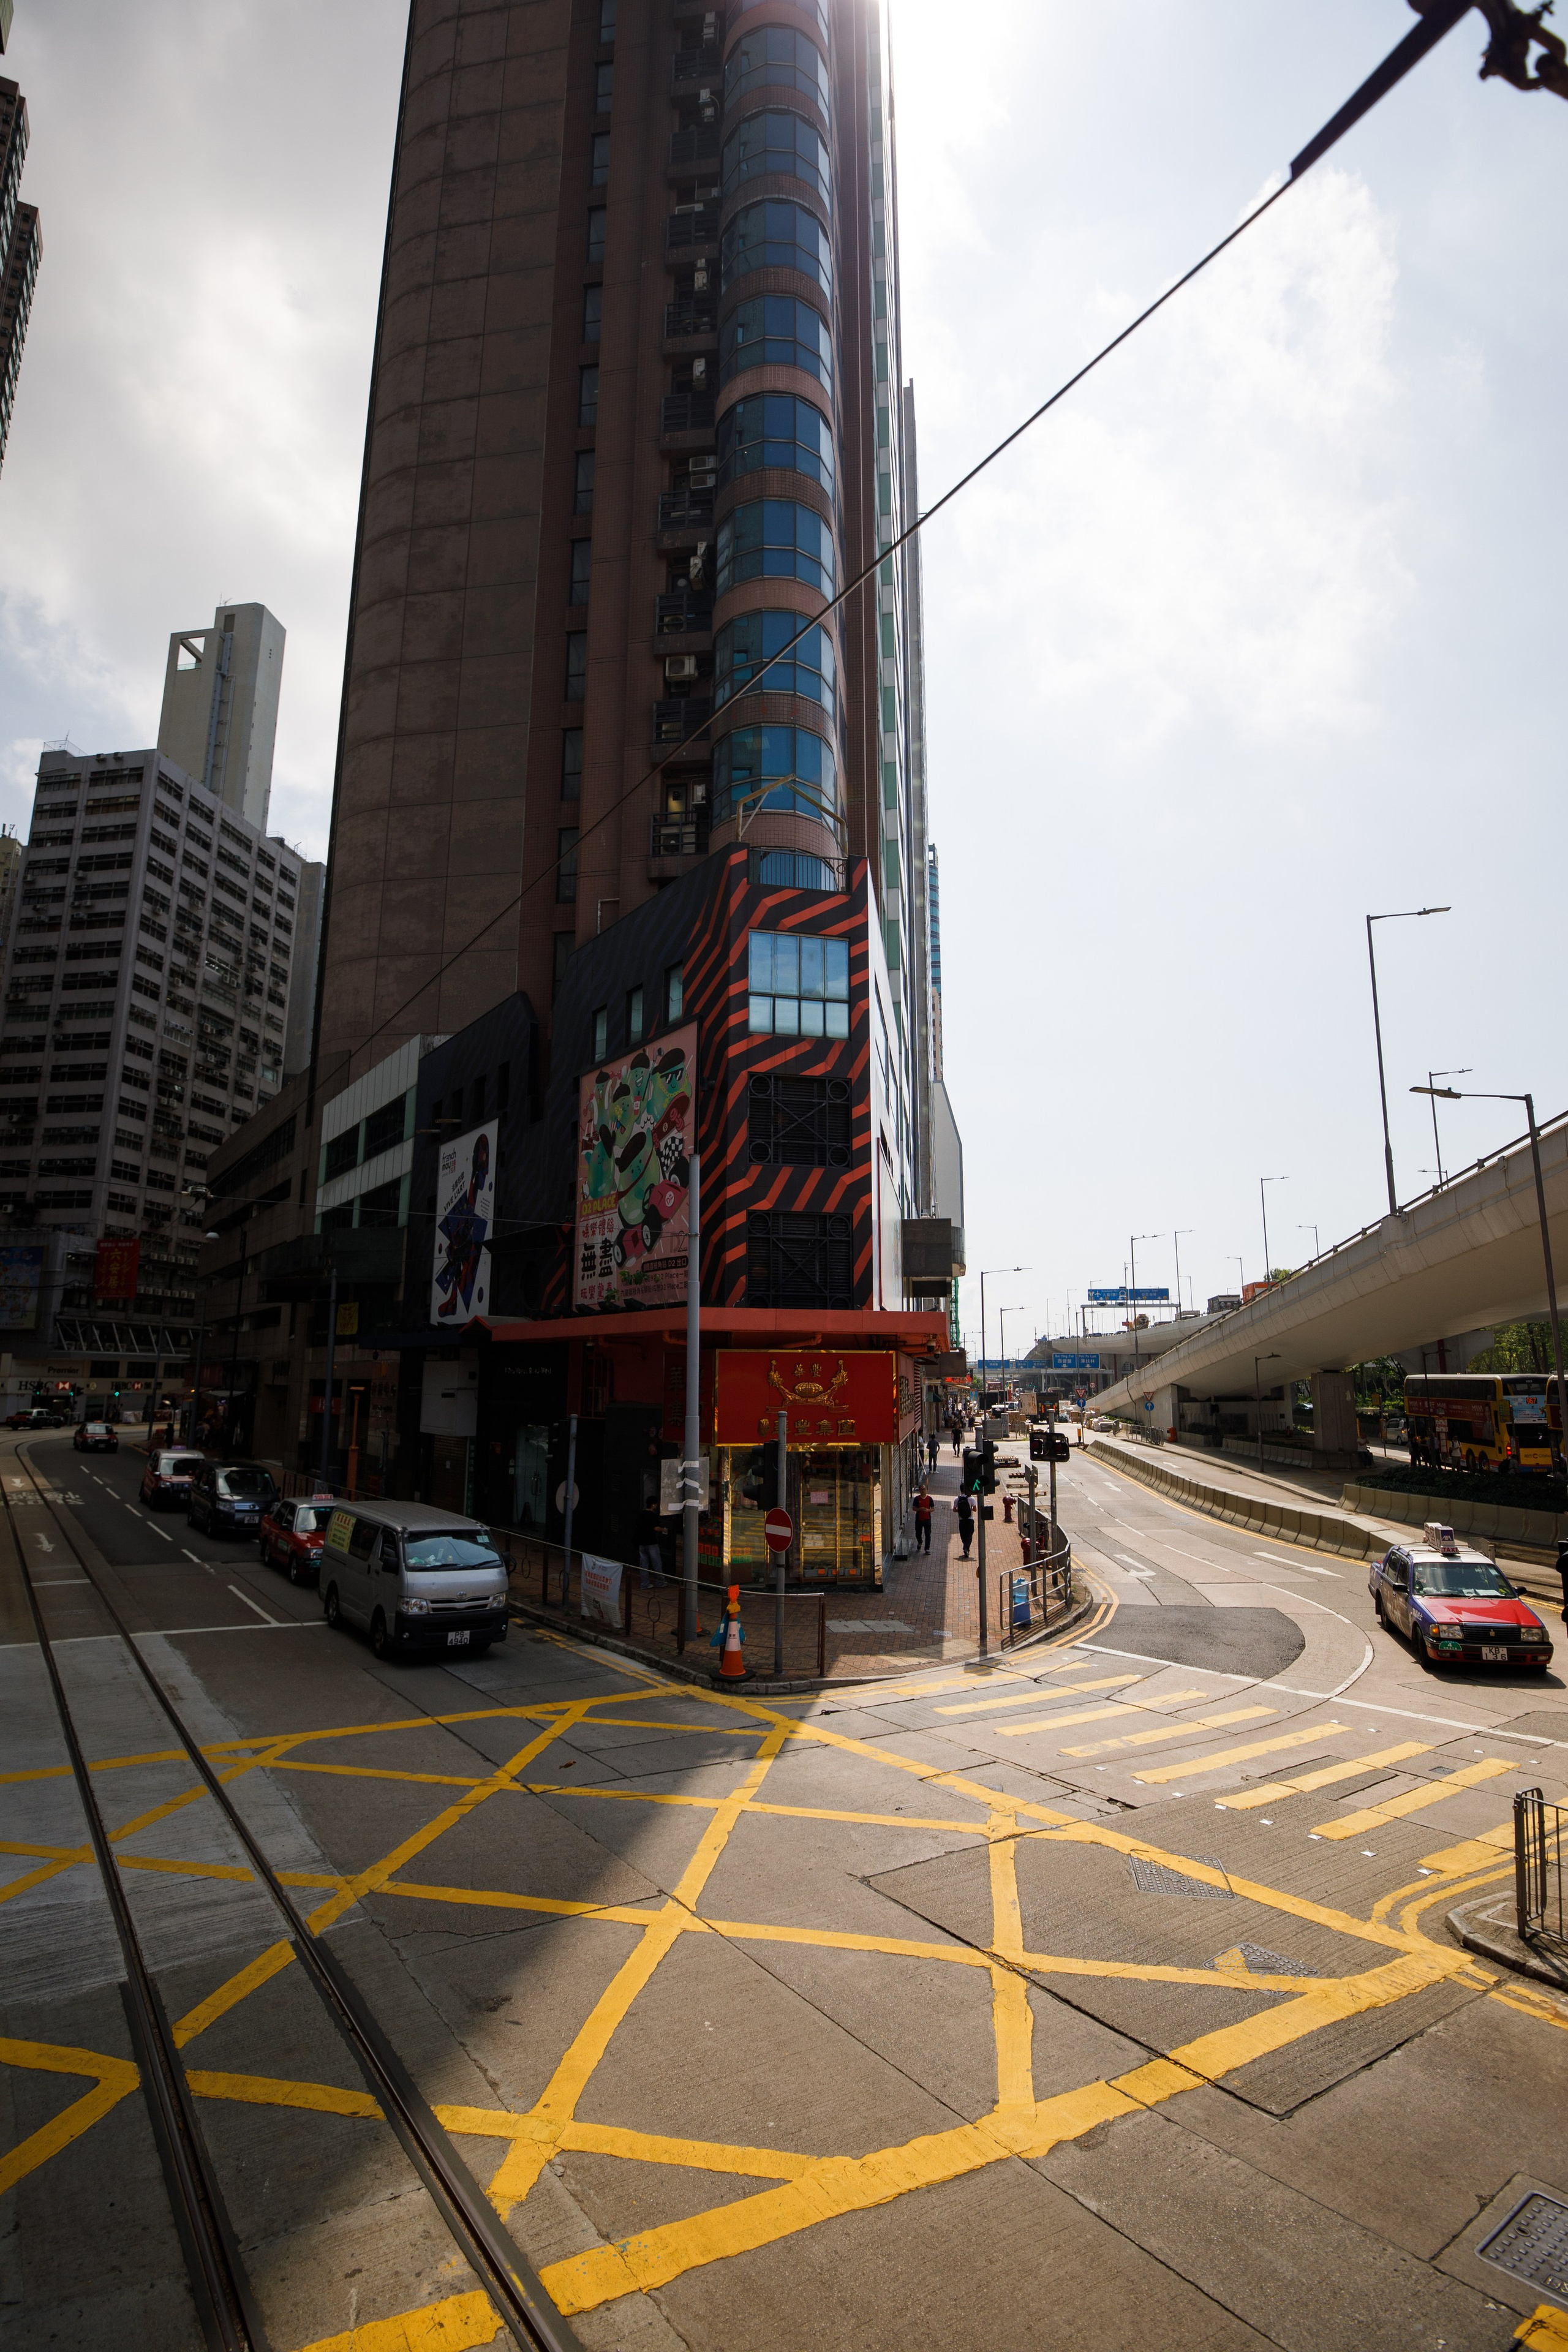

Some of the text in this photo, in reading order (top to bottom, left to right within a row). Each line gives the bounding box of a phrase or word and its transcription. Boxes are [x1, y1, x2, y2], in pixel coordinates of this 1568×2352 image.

[444, 1180, 465, 1212] VIVE L'ART
[582, 1194, 616, 1215] D2 PLACE
[581, 1237, 613, 1281] 無盡
[677, 1258, 687, 1267] 出口
[793, 1363, 822, 1378] 華豐
